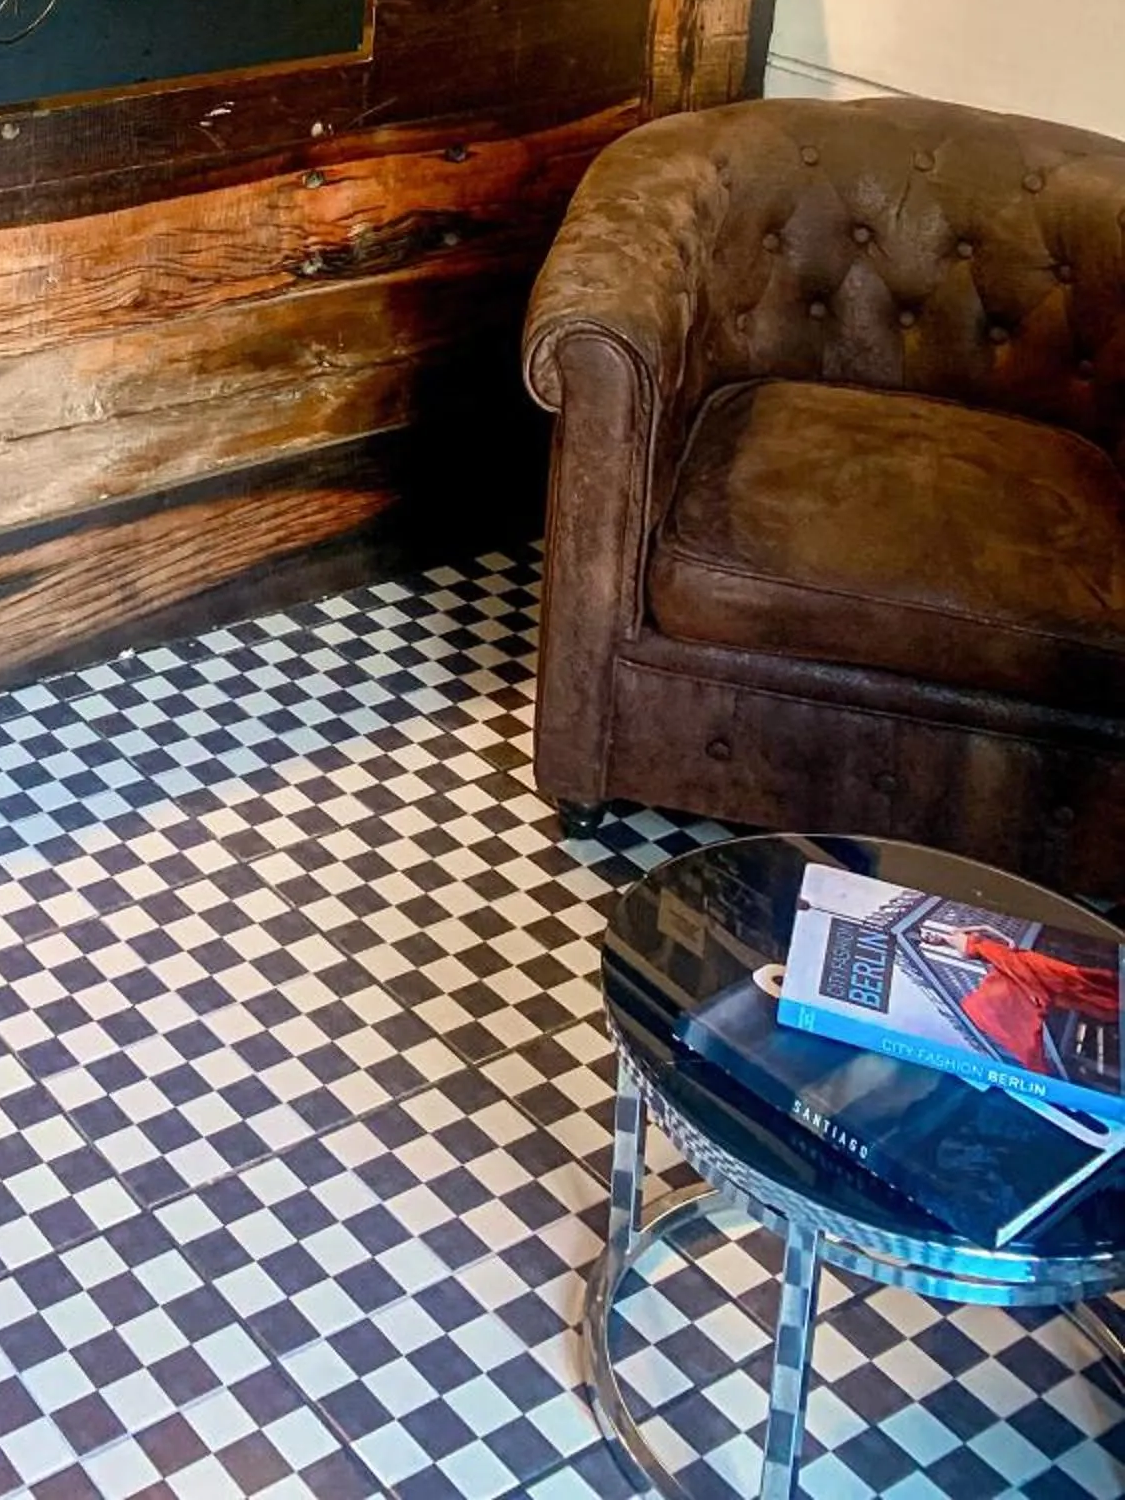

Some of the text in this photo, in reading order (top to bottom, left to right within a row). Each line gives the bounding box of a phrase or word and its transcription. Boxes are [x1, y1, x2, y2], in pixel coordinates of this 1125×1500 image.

[827, 924, 855, 997] CITY FASHION
[848, 928, 889, 1008] BERLIN
[882, 1038, 1046, 1097] CITY FASHION BERLIN
[793, 1099, 868, 1159] SANTIAGO
